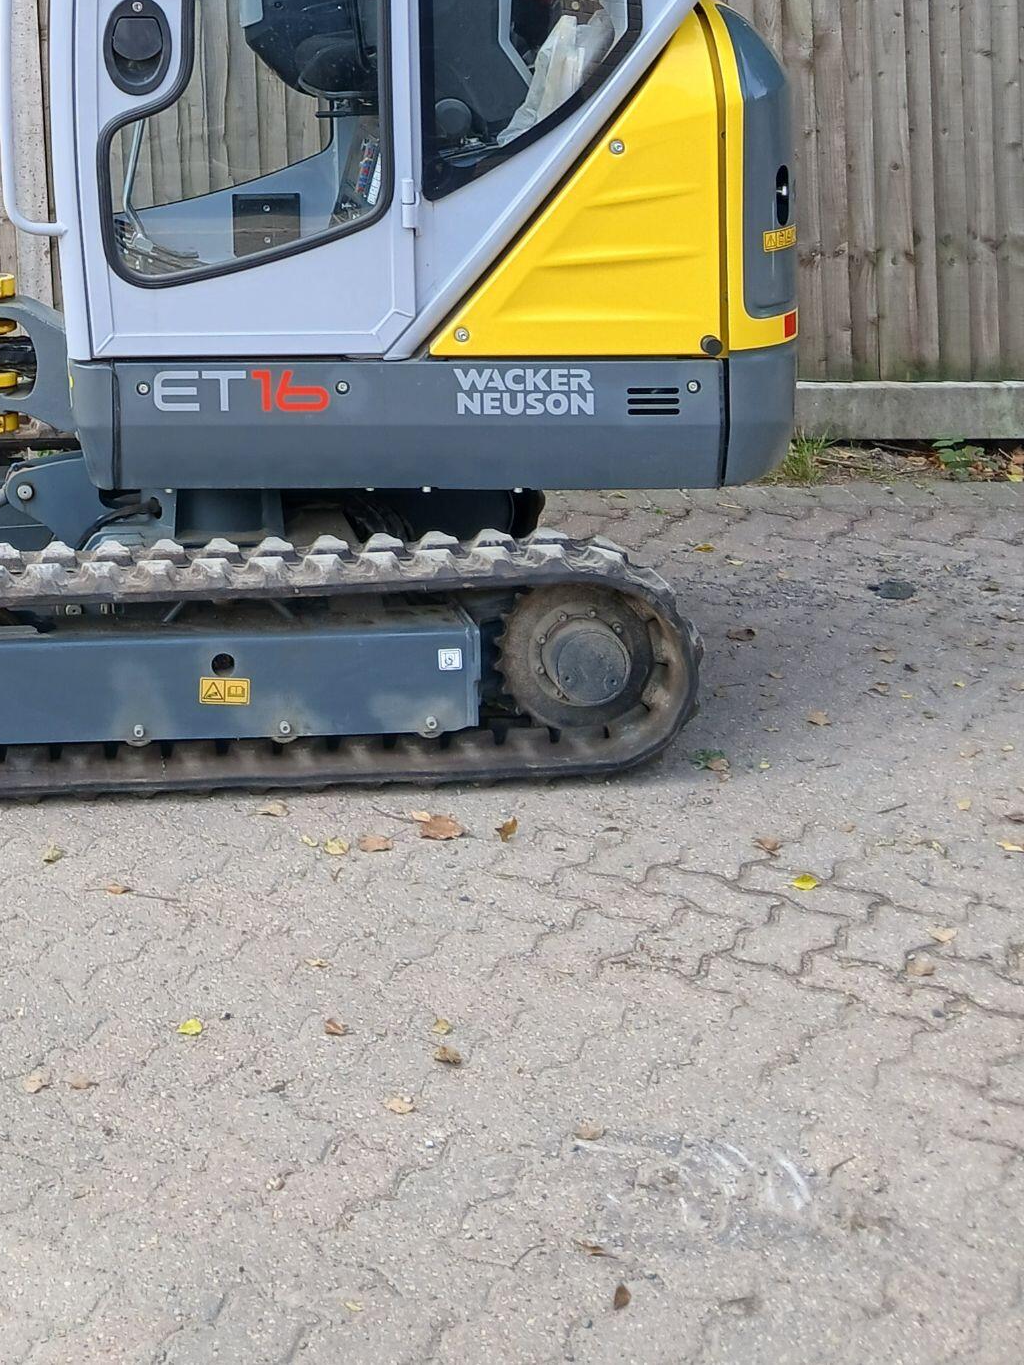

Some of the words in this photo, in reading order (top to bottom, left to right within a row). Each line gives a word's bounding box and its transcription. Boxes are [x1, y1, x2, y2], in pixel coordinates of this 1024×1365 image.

[153, 369, 331, 412] ET16
[453, 368, 595, 391] WACKER
[456, 392, 595, 415] NEUSON
